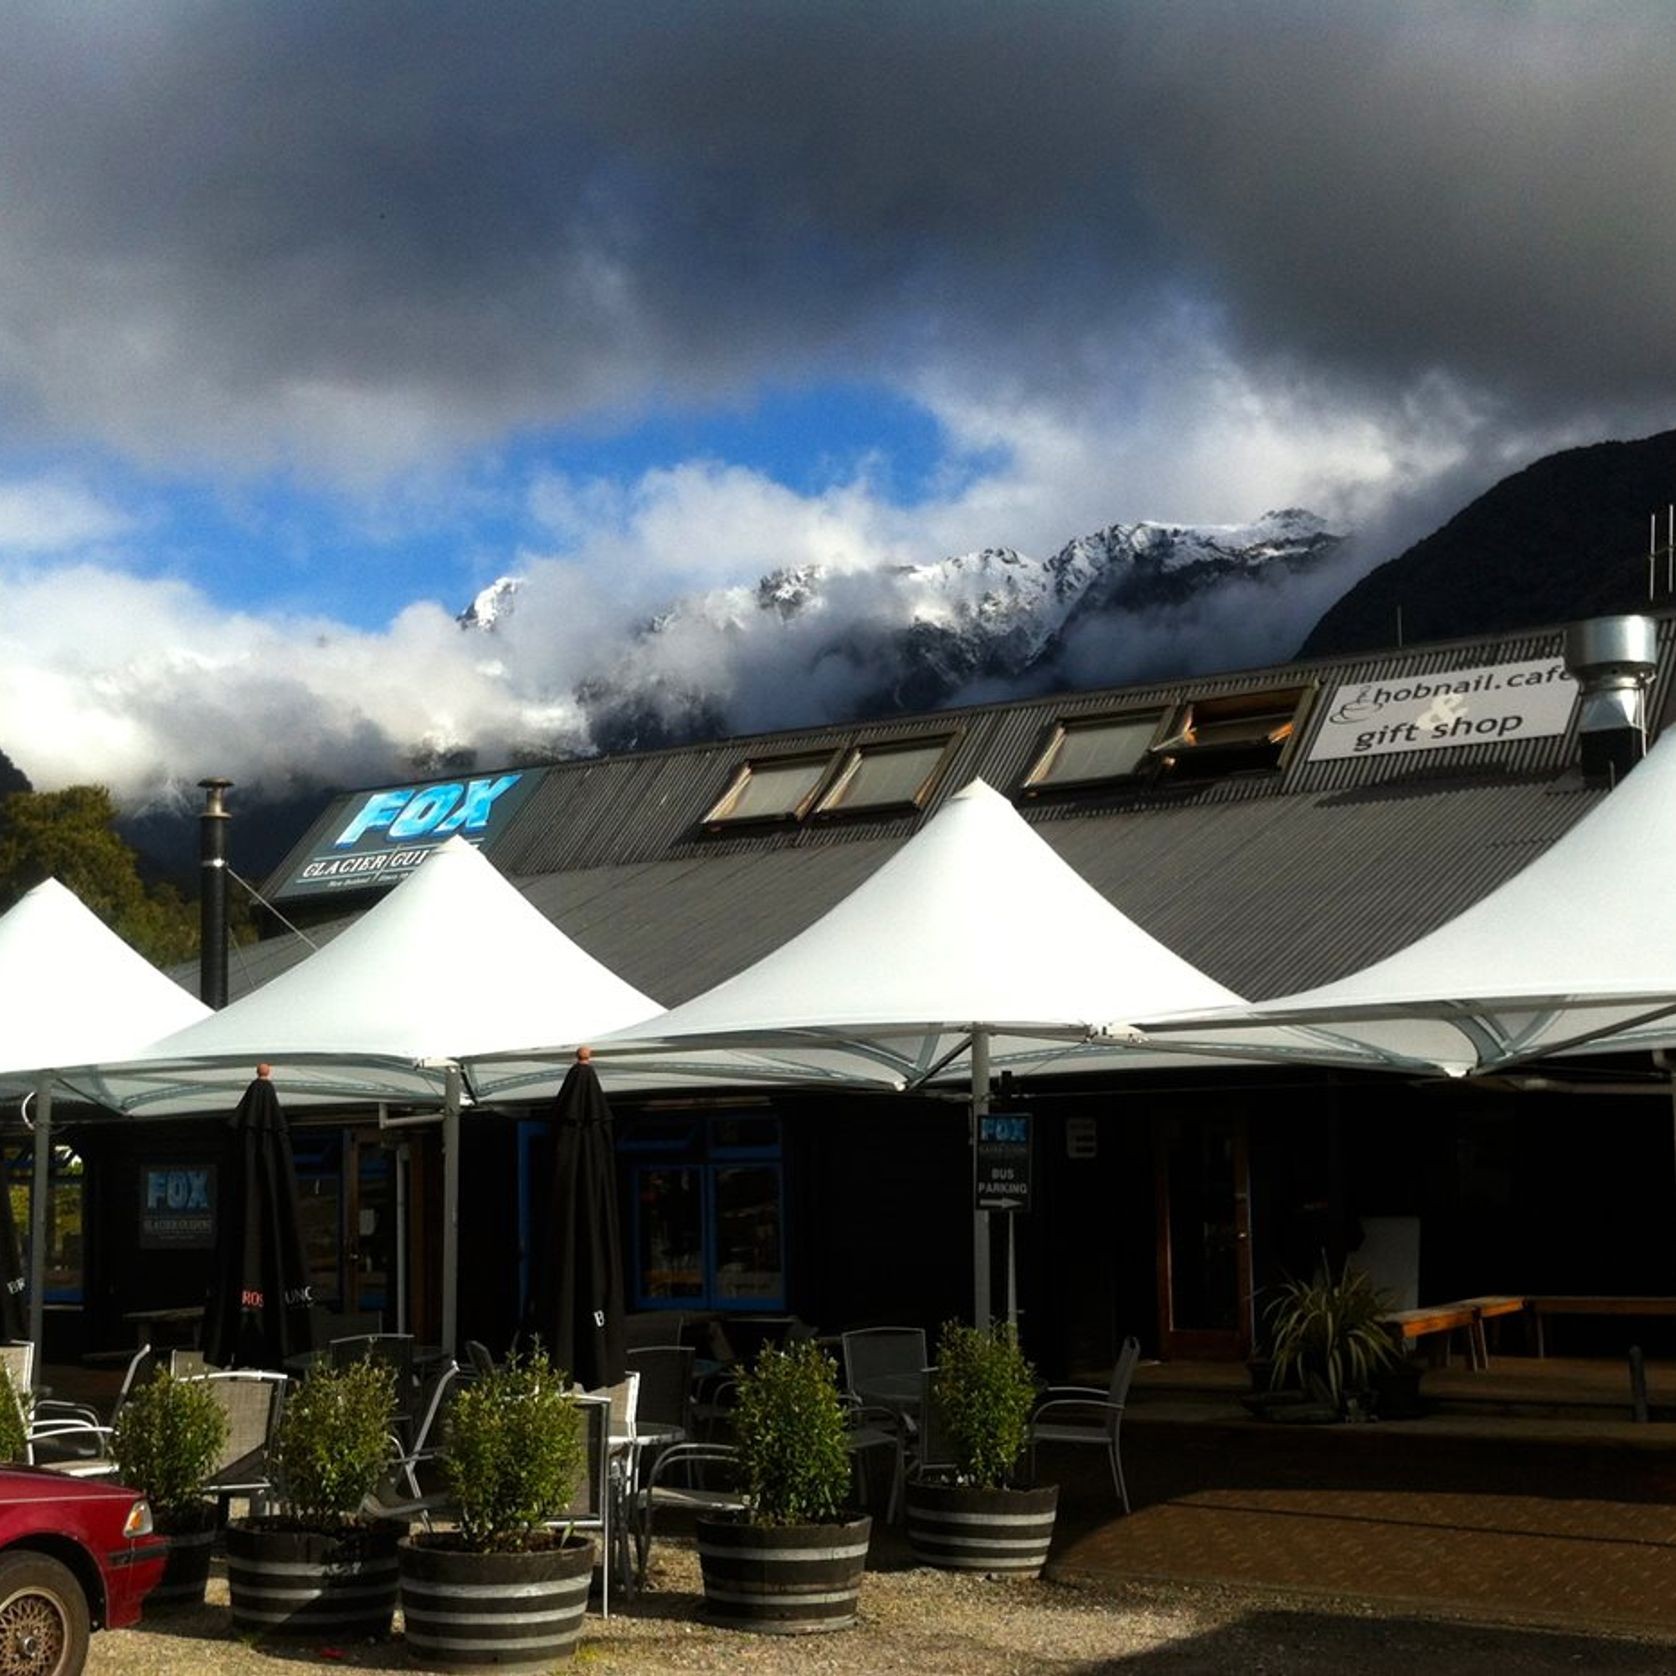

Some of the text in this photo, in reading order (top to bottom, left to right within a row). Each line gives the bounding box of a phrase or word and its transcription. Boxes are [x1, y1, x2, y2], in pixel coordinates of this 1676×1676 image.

[1416, 692, 1468, 731] &
[1353, 714, 1523, 752] gift shop
[333, 774, 523, 848] FOX
[302, 854, 386, 878] GLACIER
[980, 1117, 1026, 1142] FOX
[978, 1182, 1028, 1194] PARKING
[991, 1168, 1015, 1180] BUS
[147, 1171, 209, 1210] FOX
